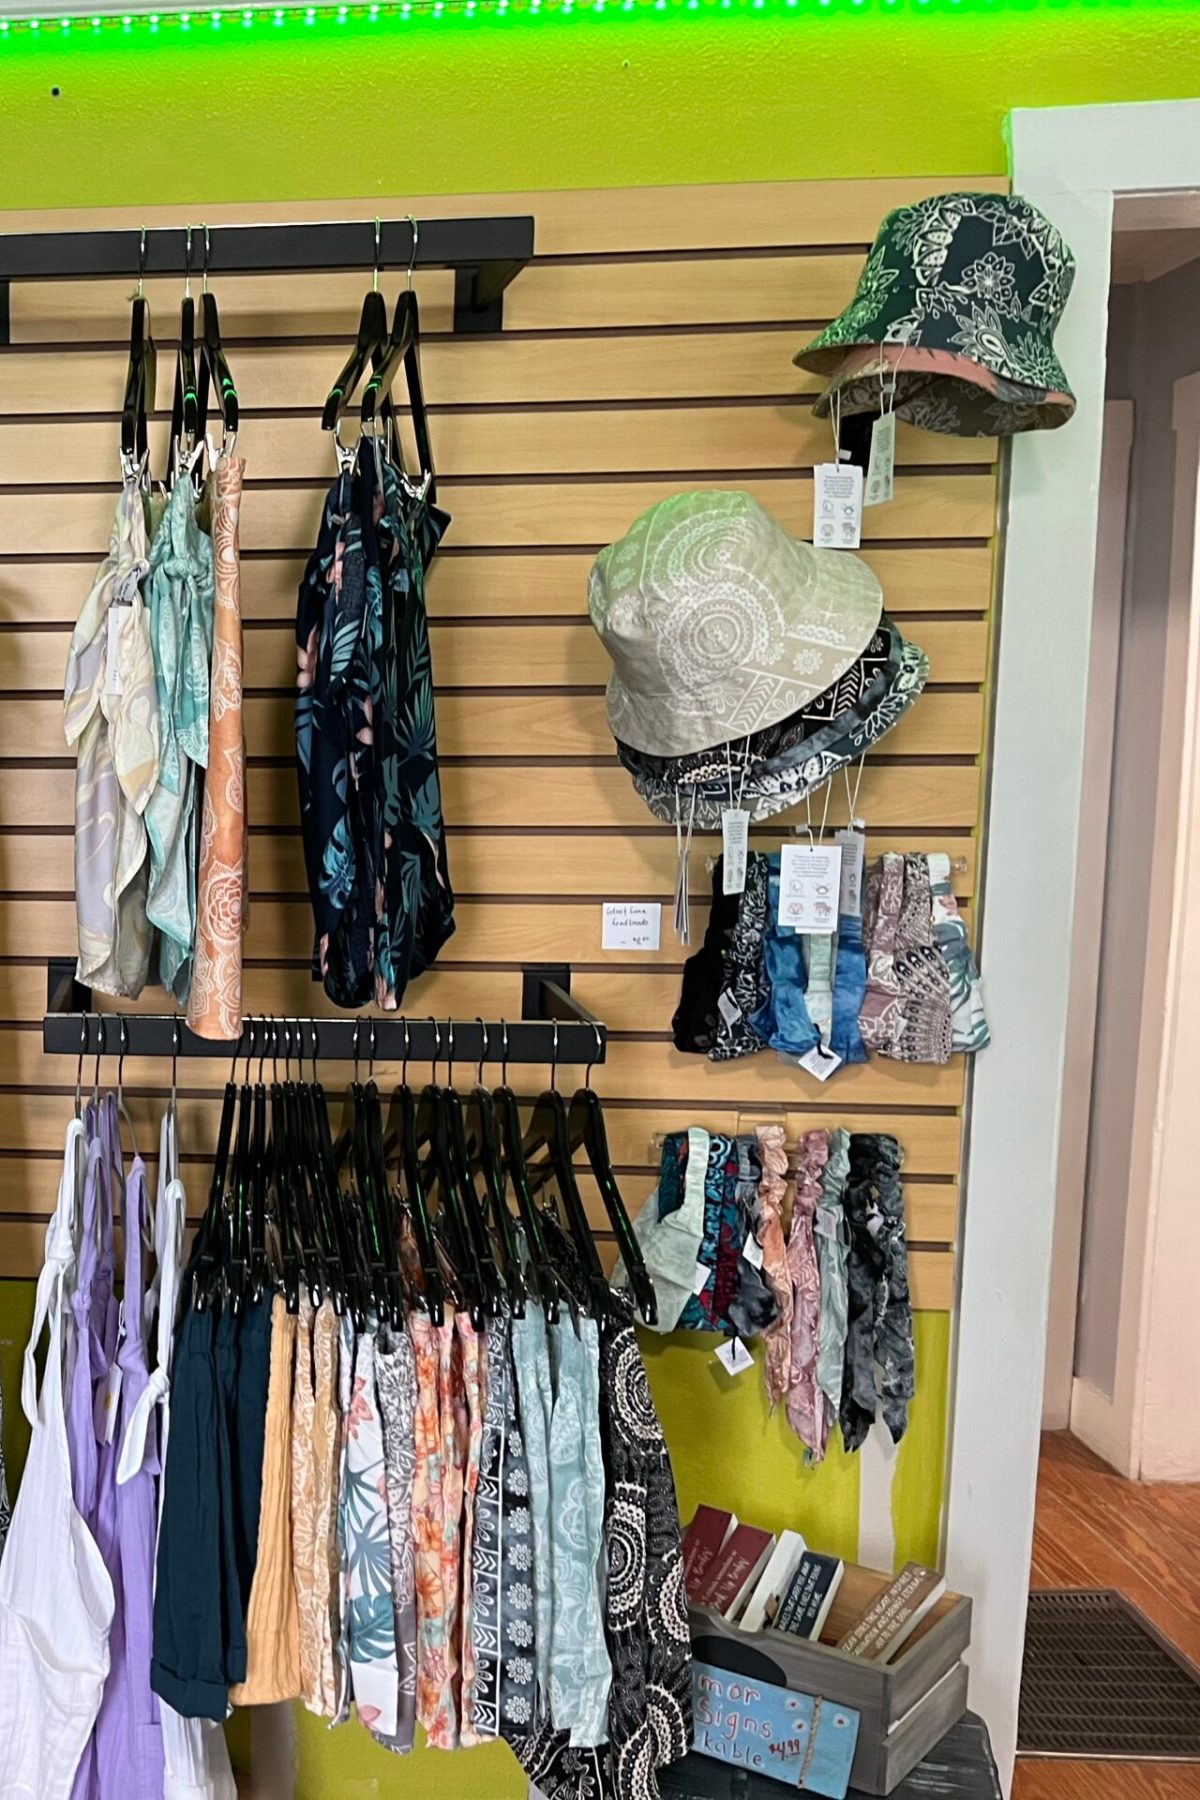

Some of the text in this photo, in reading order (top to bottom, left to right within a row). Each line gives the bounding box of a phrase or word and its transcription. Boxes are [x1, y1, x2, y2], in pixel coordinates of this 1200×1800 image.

[698, 1673, 761, 1703] mor
[694, 1693, 773, 1740] Signs
[702, 1730, 765, 1767] kable
[768, 1738, 801, 1761] $4.99
